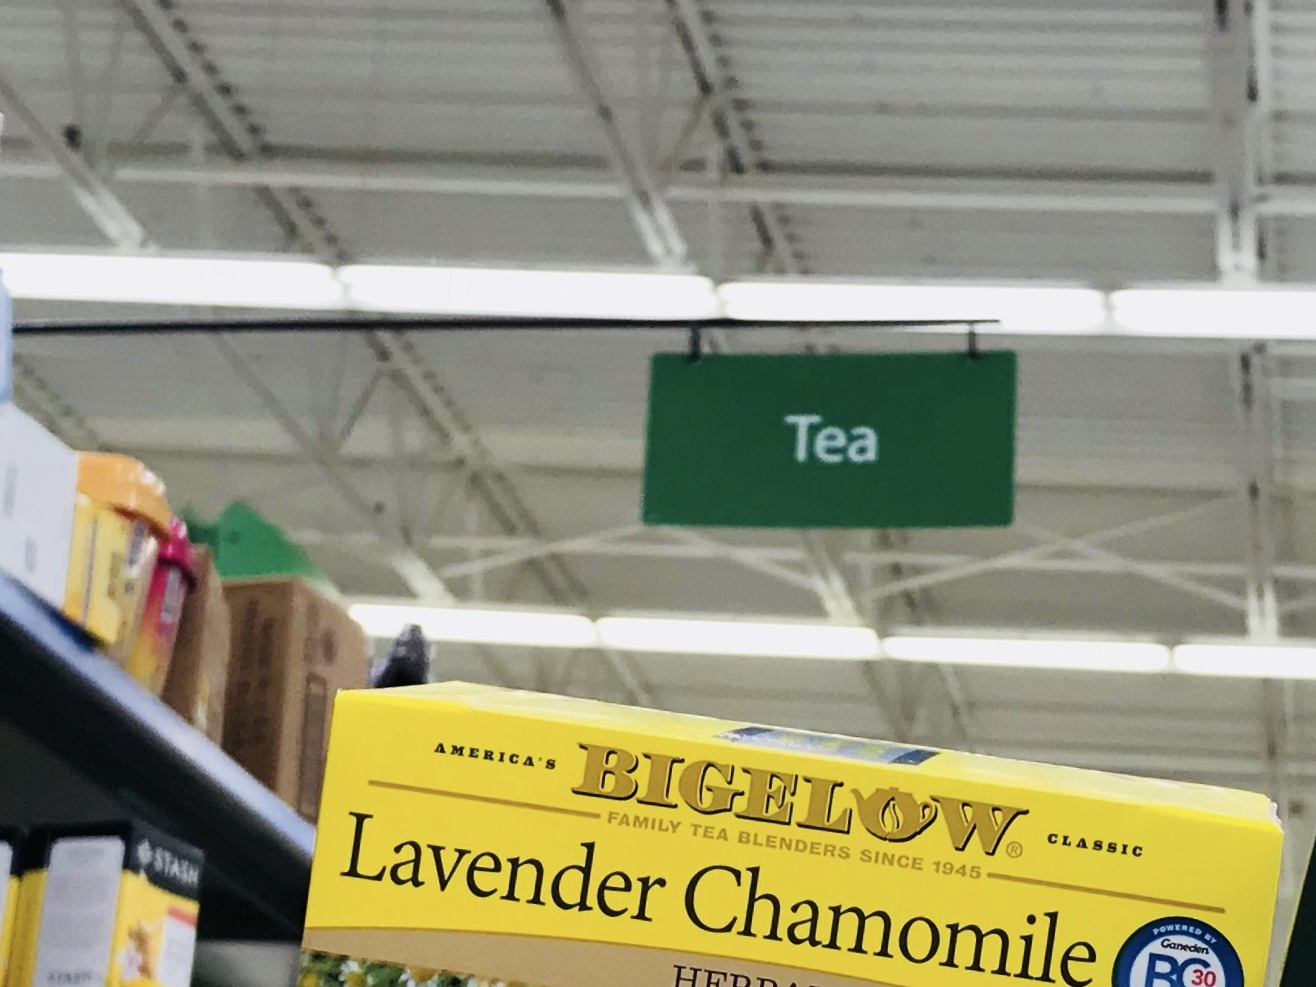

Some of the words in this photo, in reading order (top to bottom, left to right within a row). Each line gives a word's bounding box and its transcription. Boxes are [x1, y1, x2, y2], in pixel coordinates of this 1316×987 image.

[783, 413, 880, 463] Tea
[433, 743, 557, 770] AMERICA'S
[571, 742, 1029, 857] BIGELOW
[607, 812, 681, 834] FAMILY
[690, 823, 730, 842] TEA
[738, 831, 852, 860] BLENDERS
[860, 849, 924, 871] SINCE
[932, 860, 982, 880] 1945
[1047, 833, 1144, 857] CLASSIC
[341, 811, 667, 922] Lavender
[1152, 924, 1202, 936] POWERED
[1204, 933, 1218, 944] BY
[1160, 938, 1209, 955] Ganeden
